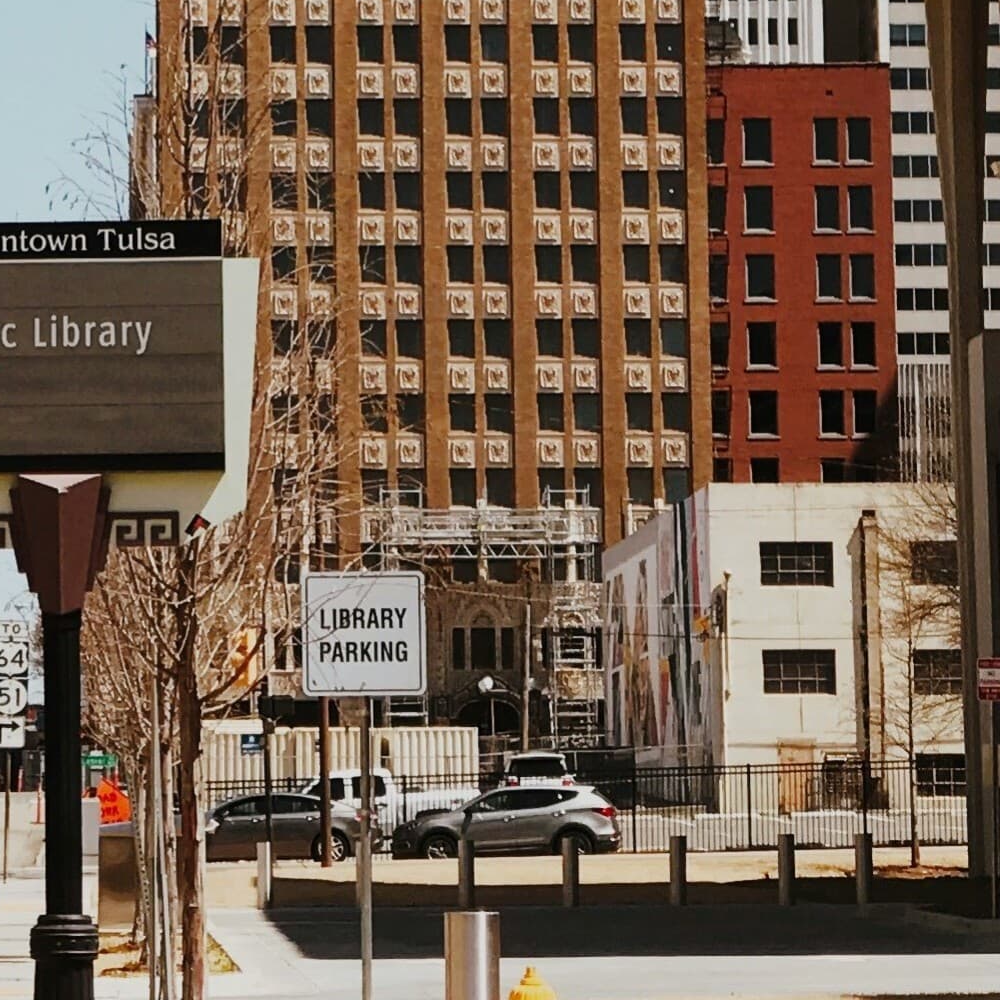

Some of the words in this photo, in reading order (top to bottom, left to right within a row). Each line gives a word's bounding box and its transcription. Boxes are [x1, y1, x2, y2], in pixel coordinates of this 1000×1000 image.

[96, 227, 176, 251] Tulsa
[33, 314, 153, 355] Library
[2, 624, 21, 634] TO
[319, 607, 408, 630] LIBRARY
[319, 641, 409, 663] PARKING
